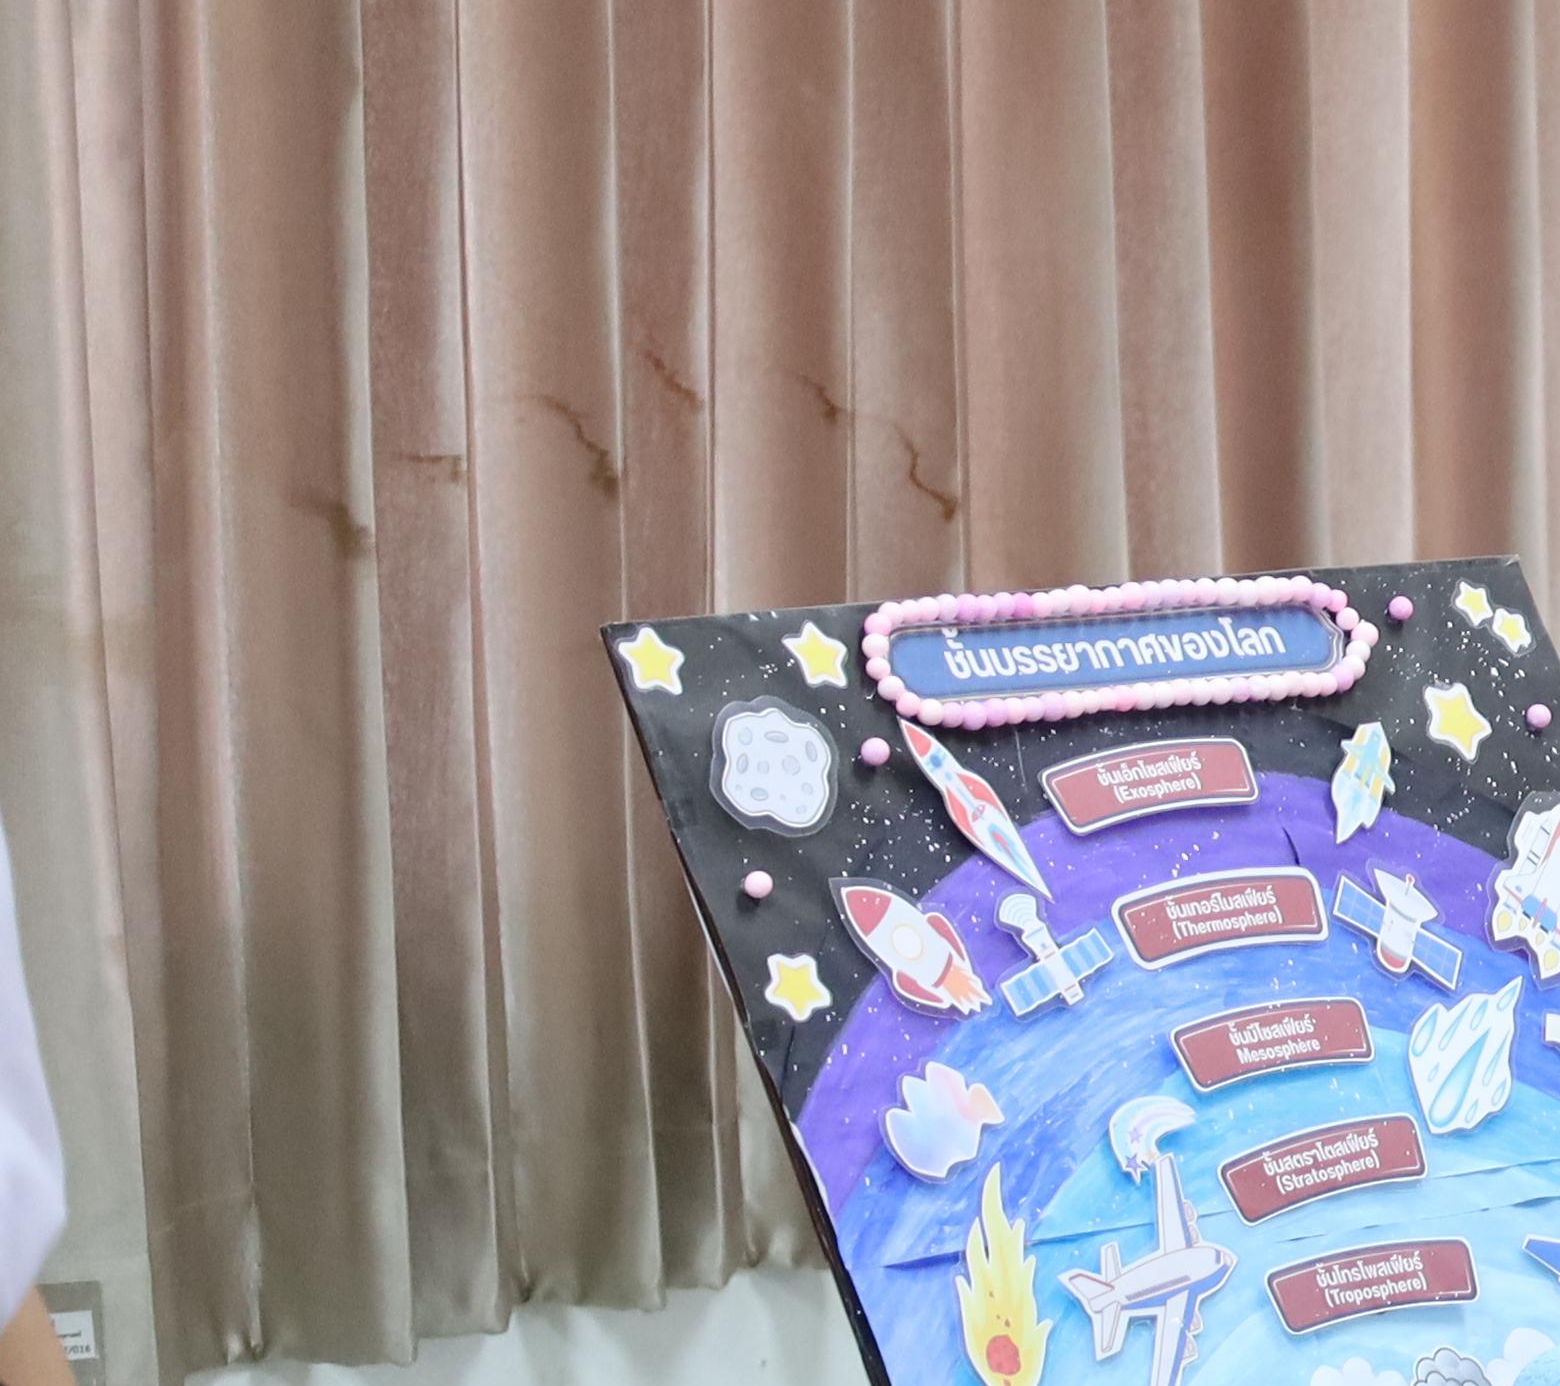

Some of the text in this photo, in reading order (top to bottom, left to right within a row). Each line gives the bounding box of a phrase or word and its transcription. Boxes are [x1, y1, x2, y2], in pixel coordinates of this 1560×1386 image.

[943, 616, 1286, 680] ชั้นบรรยากาศของโลก
[1114, 775, 1203, 804] (Exosphere)
[1172, 907, 1283, 942] (Thermosphere)
[1237, 1035, 1321, 1066] Mesosphere
[1276, 1151, 1380, 1196] (Stratosphere)
[1324, 1273, 1427, 1309] (Troposphere)
